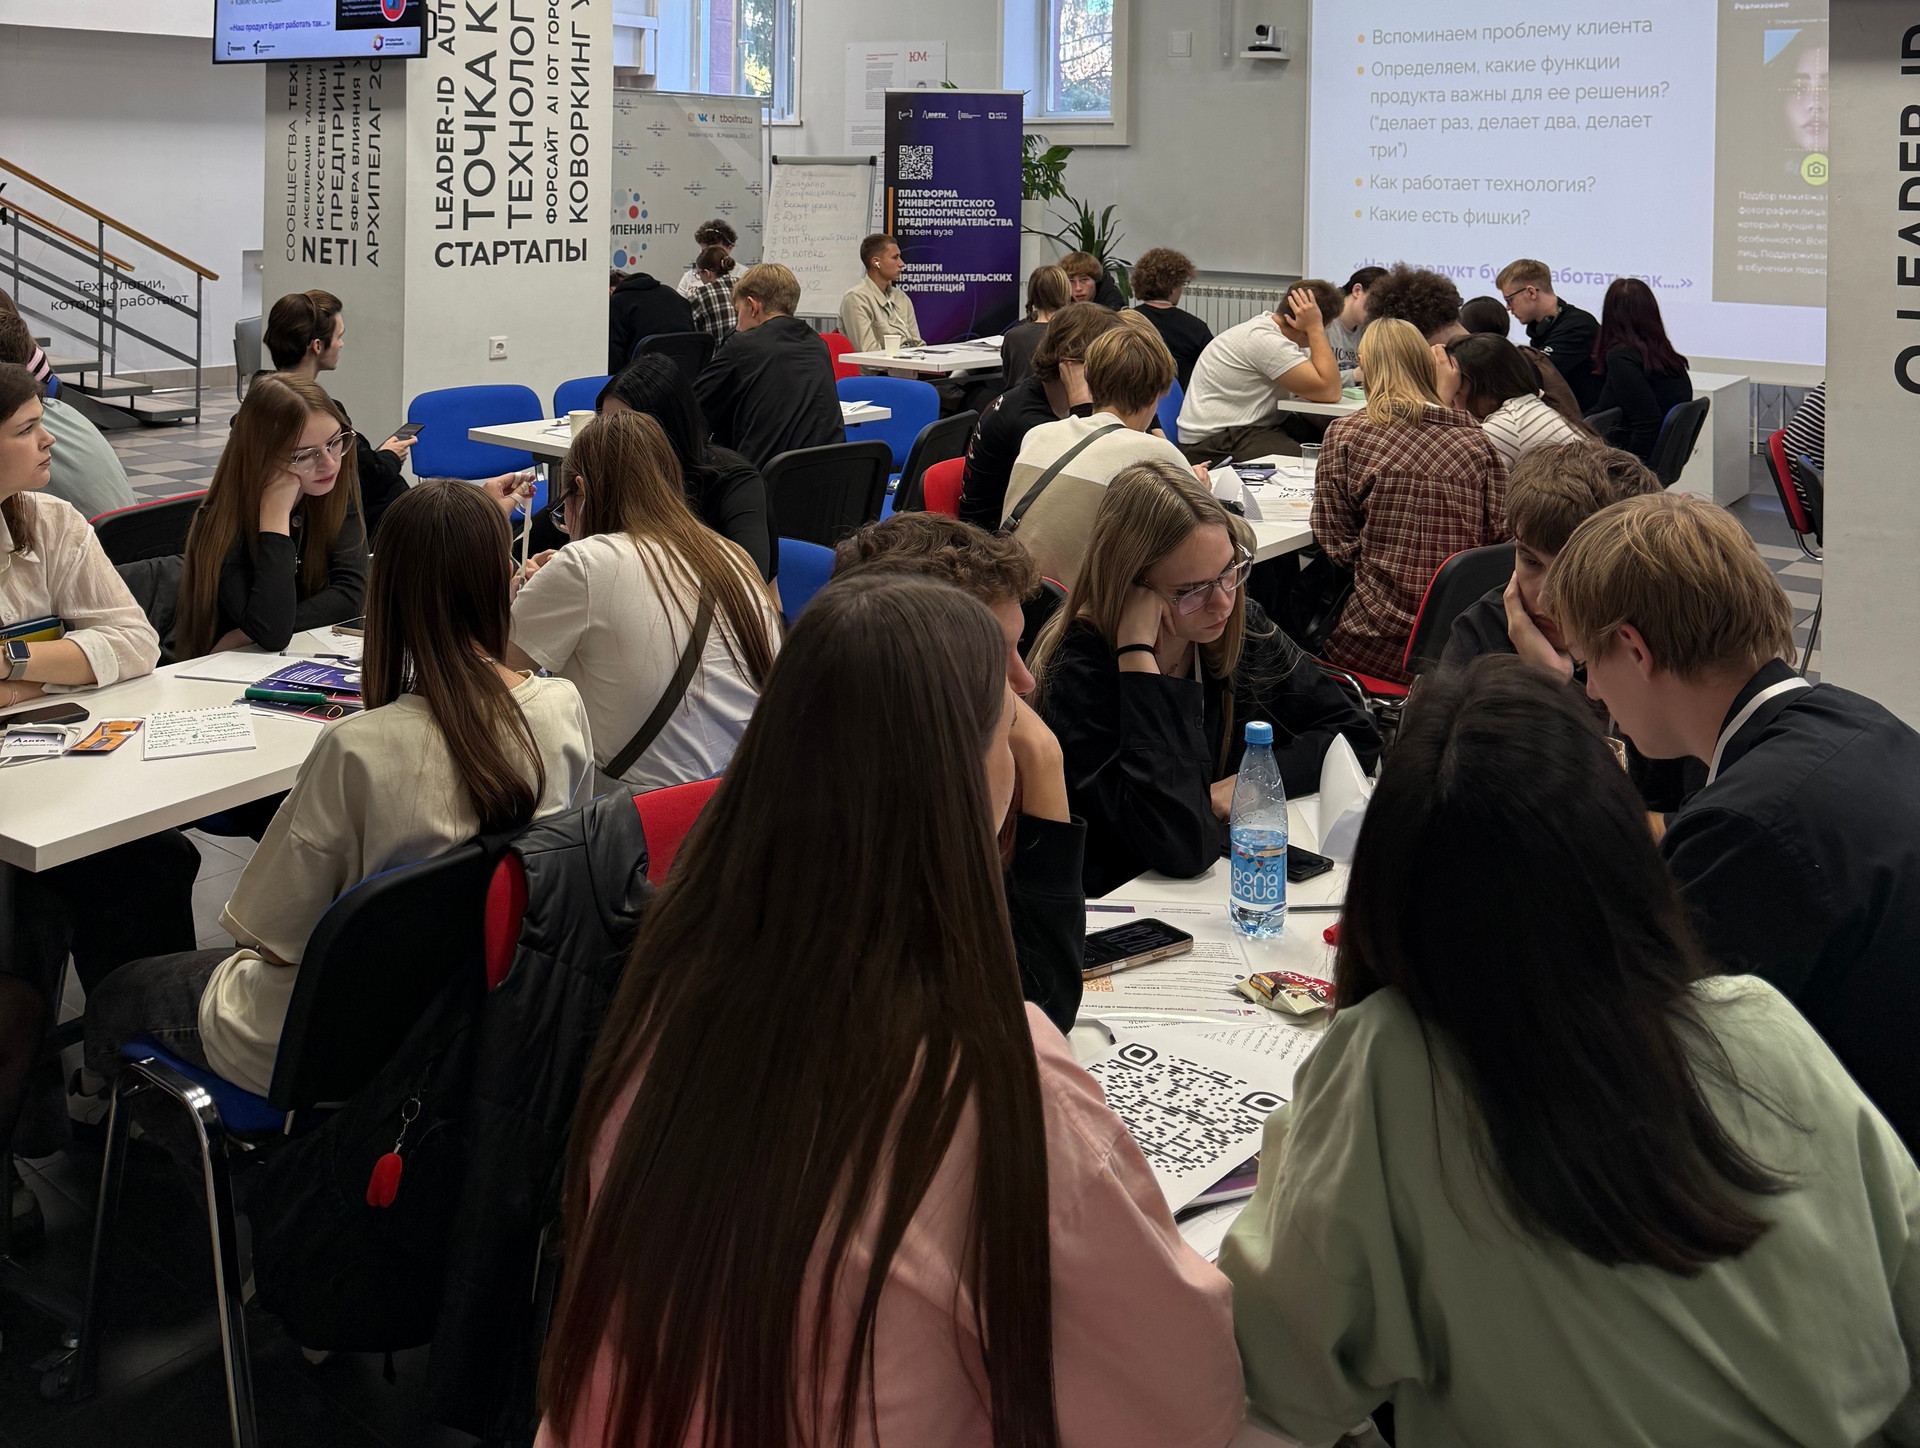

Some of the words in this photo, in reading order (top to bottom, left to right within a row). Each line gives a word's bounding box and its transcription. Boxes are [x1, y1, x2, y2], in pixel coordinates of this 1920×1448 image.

[245, 23, 268, 32] продукт
[268, 21, 285, 31] будет
[286, 20, 311, 30] работать
[465, 0, 498, 34] К
[1372, 28, 1477, 45] Вспоминаем
[1482, 21, 1572, 44] проблему
[1577, 19, 1653, 36] клиента
[547, 54, 559, 86] IOT
[1371, 60, 1480, 79] Определяем,
[1485, 58, 1536, 73] какие
[1541, 55, 1620, 75] функции
[1370, 90, 1446, 107] продукта
[1451, 88, 1506, 103] важны
[1511, 87, 1542, 103] для
[1548, 86, 1570, 101] ее
[1575, 80, 1670, 104] решения?
[507, 0, 535, 230] ТЕХНОЛОГ
[547, 96, 559, 115] AI
[352, 77, 361, 166] ВЛИЯНИЯ
[569, 21, 591, 224] КОВОРКИНГ
[1441, 116, 1473, 133] раз,
[1477, 115, 1541, 132] делает
[1544, 115, 1580, 132] два,
[1585, 114, 1653, 131] делает
[463, 50, 498, 231] ТОЧКА
[435, 76, 455, 230] LEADER-ID
[303, 135, 311, 229] АКСЕЛЕРАЦИЯ
[367, 97, 381, 268] АРХИПЕЛАГ
[544, 127, 559, 225] ФОРСАЙТ
[1369, 174, 1398, 190] Как
[1402, 174, 1480, 194] работает
[1484, 176, 1597, 192] технология?
[286, 119, 298, 262] СООБЩЕСТВА
[898, 189, 958, 198] ПЛАТФОРМА
[1738, 191, 1777, 202] Подбор
[898, 199, 995, 208] УНИВЕРСИТЕТСКОГО
[898, 208, 997, 217] ТЕХНОЛОГИЧЕСКОГО
[1738, 206, 1799, 216] фотографии
[898, 218, 1013, 227] ПРЕДПРИНИМАТЕЛЬСТВА
[1369, 206, 1418, 222] Какие
[1422, 209, 1459, 223] есть
[1463, 208, 1531, 228] фишки?
[1737, 220, 1780, 229] который
[654, 223, 680, 235] НГТУ
[933, 229, 953, 238] вузе
[302, 235, 357, 267] NETI
[434, 238, 588, 268] СТАРТАПЫ
[75, 279, 166, 293] Технологии,
[1551, 267, 1620, 285] аботат
[896, 282, 966, 294] КОМПЕТЕНЦИЙ
[51, 298, 115, 312] которые
[119, 294, 189, 311] работают
[1233, 863, 1279, 885] bona
[1233, 880, 1279, 902] aqua
